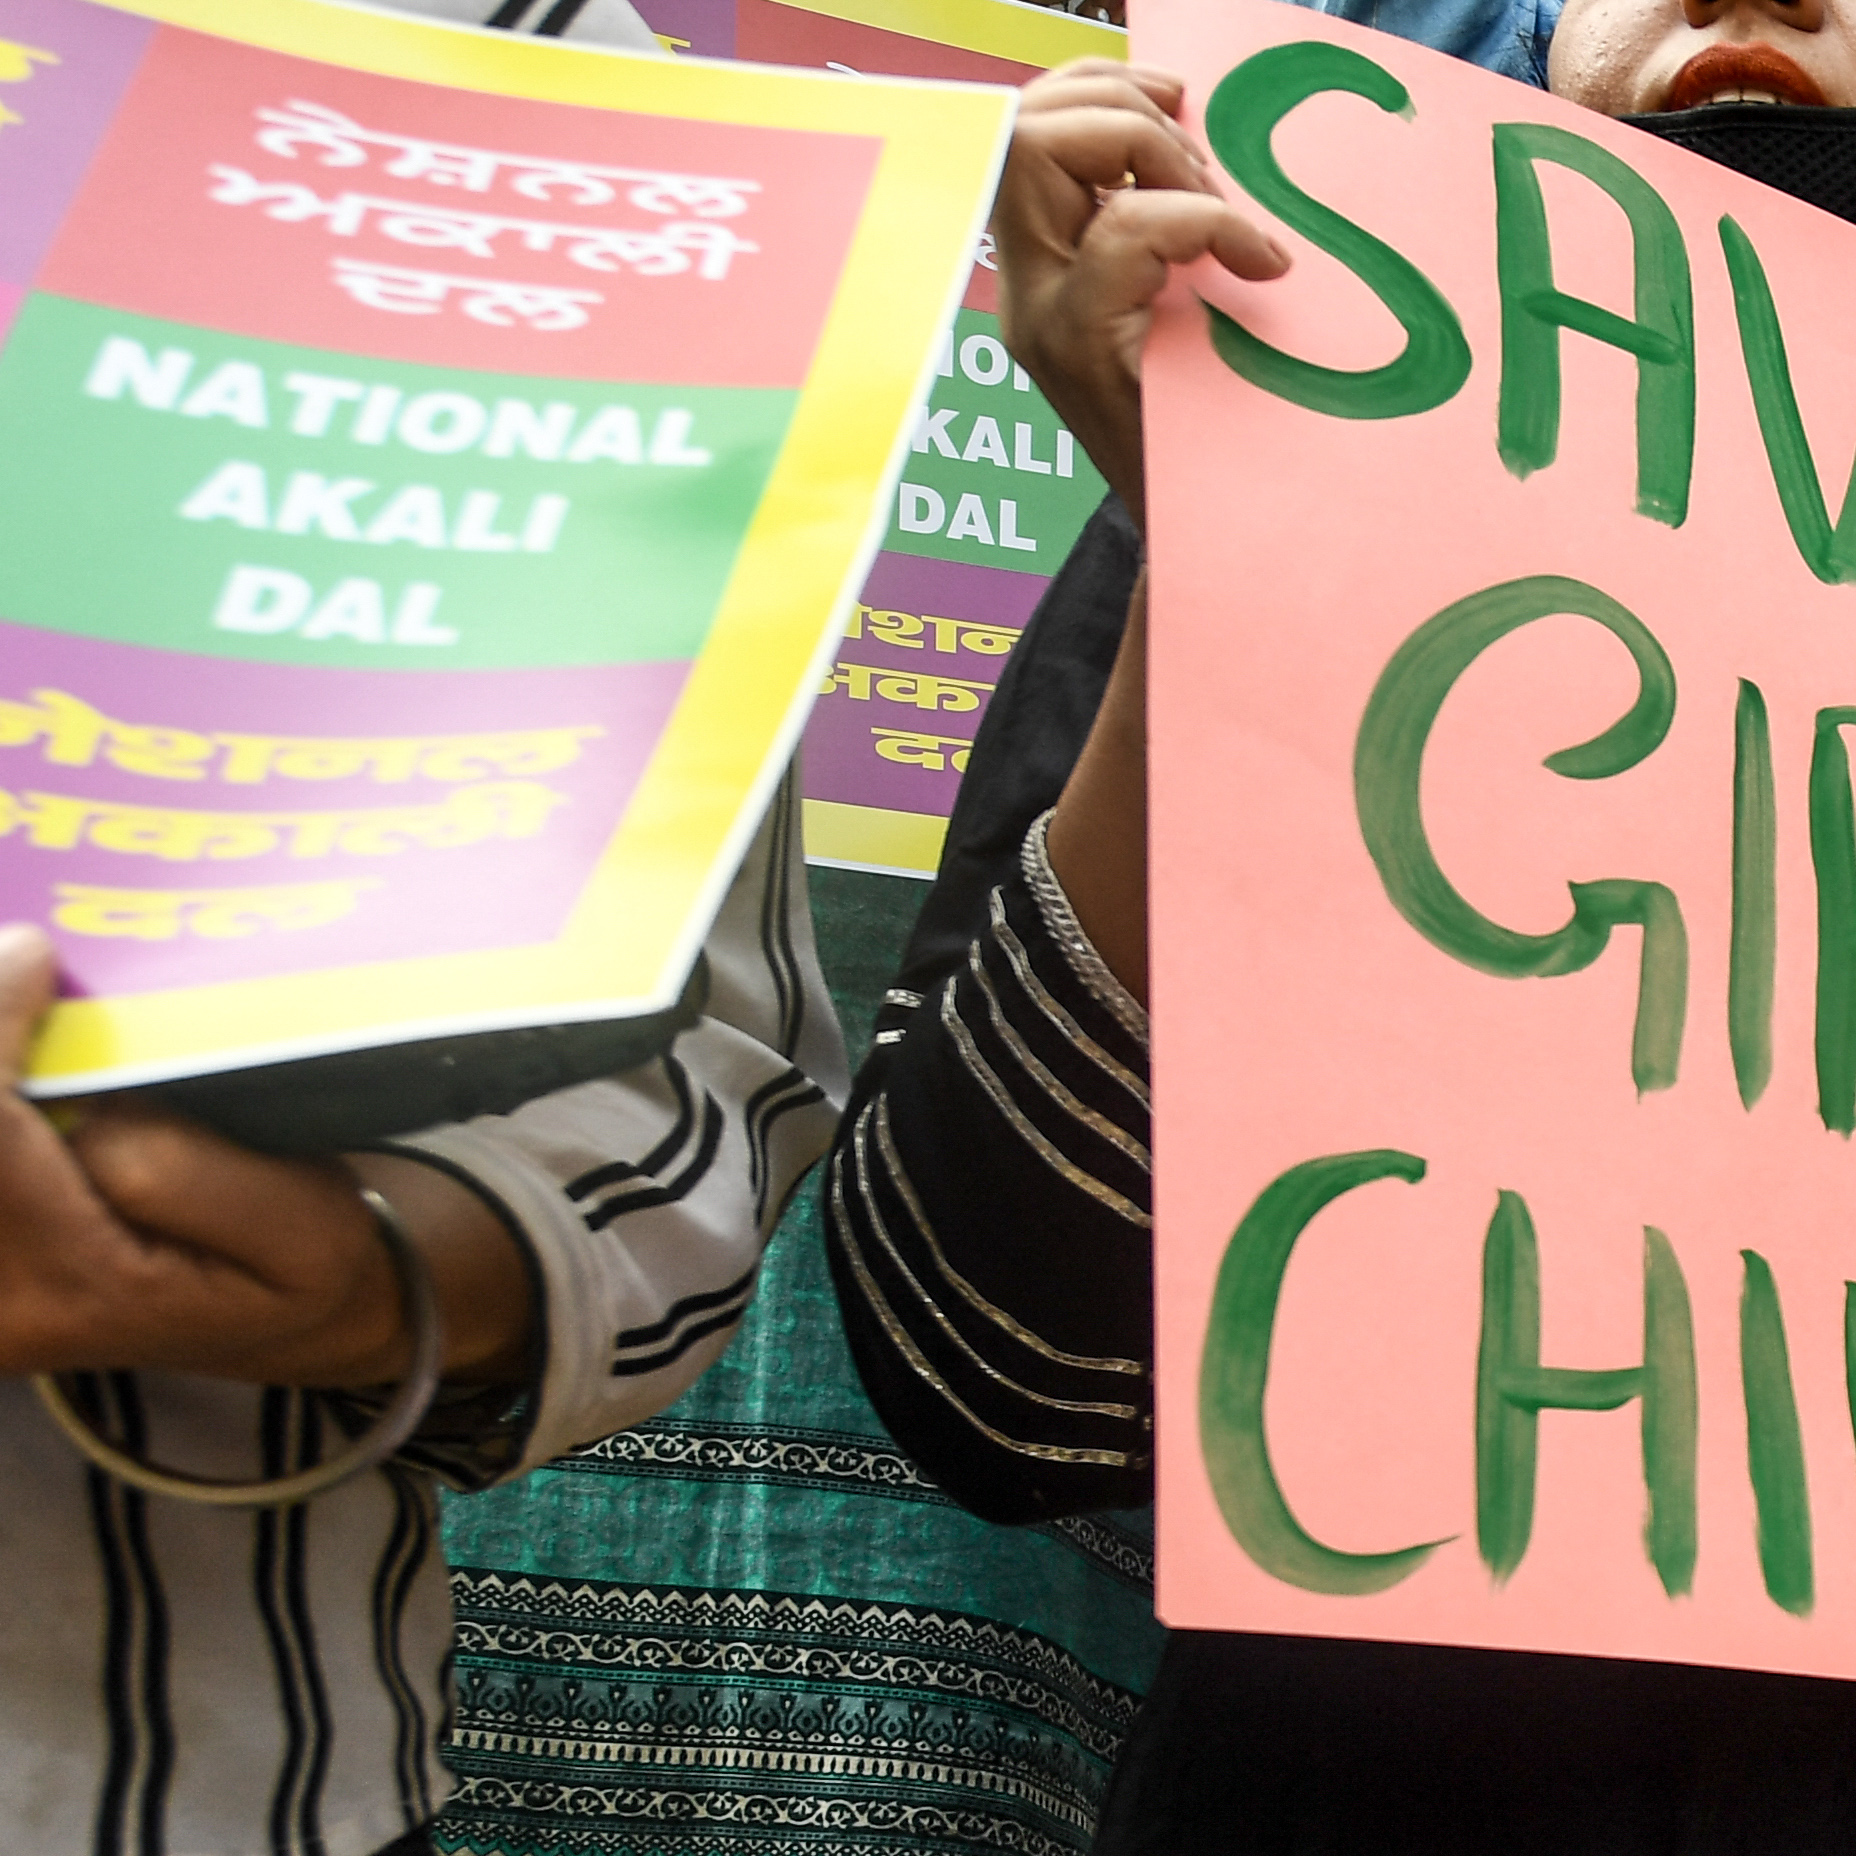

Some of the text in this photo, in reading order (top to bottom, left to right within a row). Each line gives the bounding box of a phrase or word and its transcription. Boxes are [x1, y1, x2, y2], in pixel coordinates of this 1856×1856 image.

[205, 162, 762, 283] ਅਕਾਲੀ
[330, 256, 606, 332] ਦਲ
[84, 335, 714, 468] NATIONAL
[911, 405, 1075, 478] KALI
[177, 459, 572, 554] AKALI
[898, 482, 1038, 552] DAL
[212, 562, 461, 646] DAL
[52, 874, 388, 942] दल
